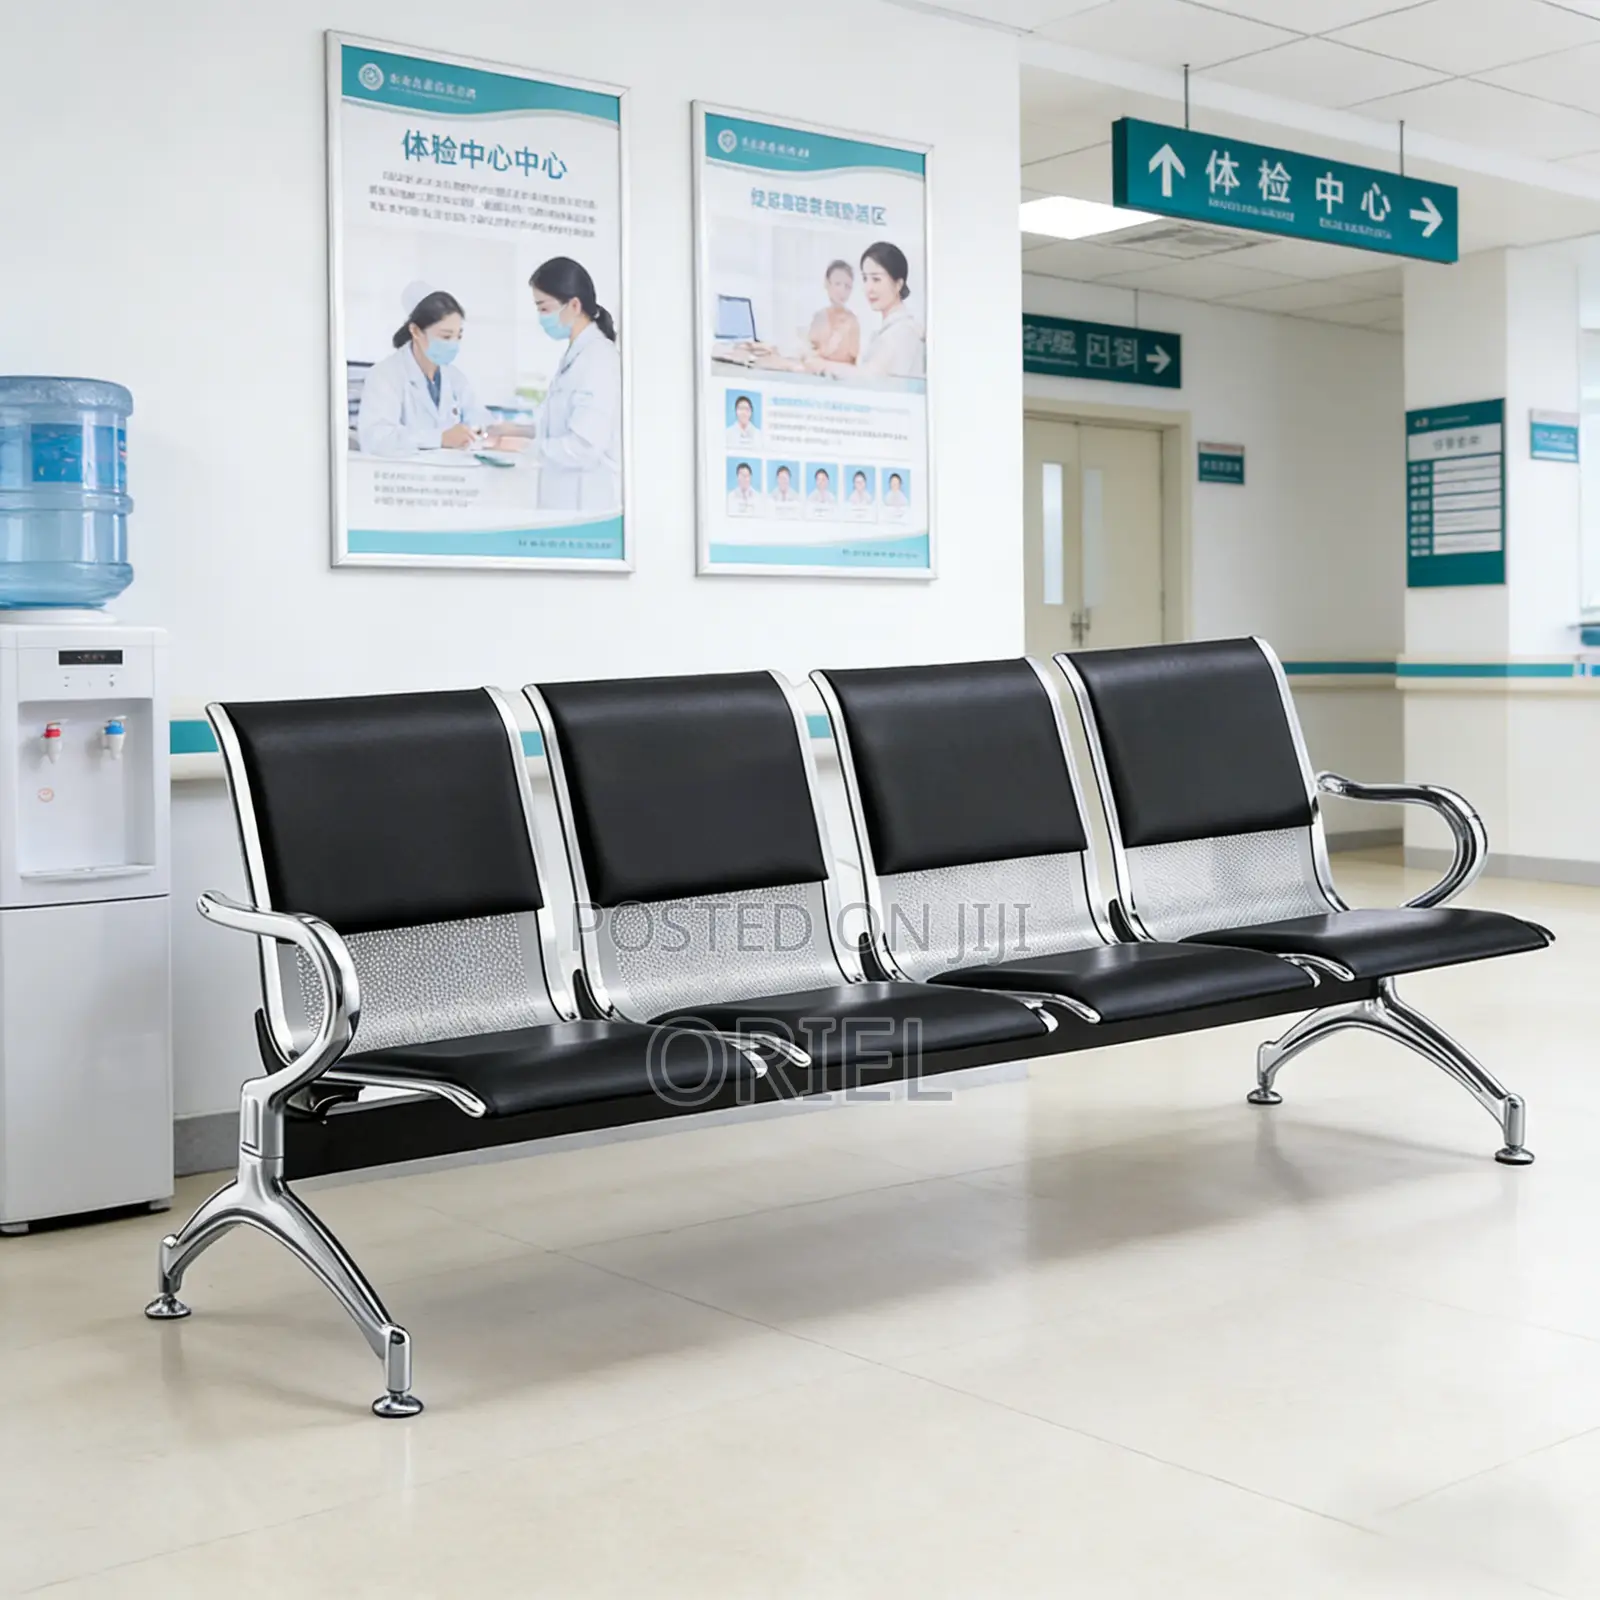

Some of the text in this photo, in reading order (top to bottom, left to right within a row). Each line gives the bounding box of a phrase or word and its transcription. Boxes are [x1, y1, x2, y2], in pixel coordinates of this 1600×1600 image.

[402, 129, 568, 180] 体验中心中心
[1205, 150, 1391, 222] 体检中心
